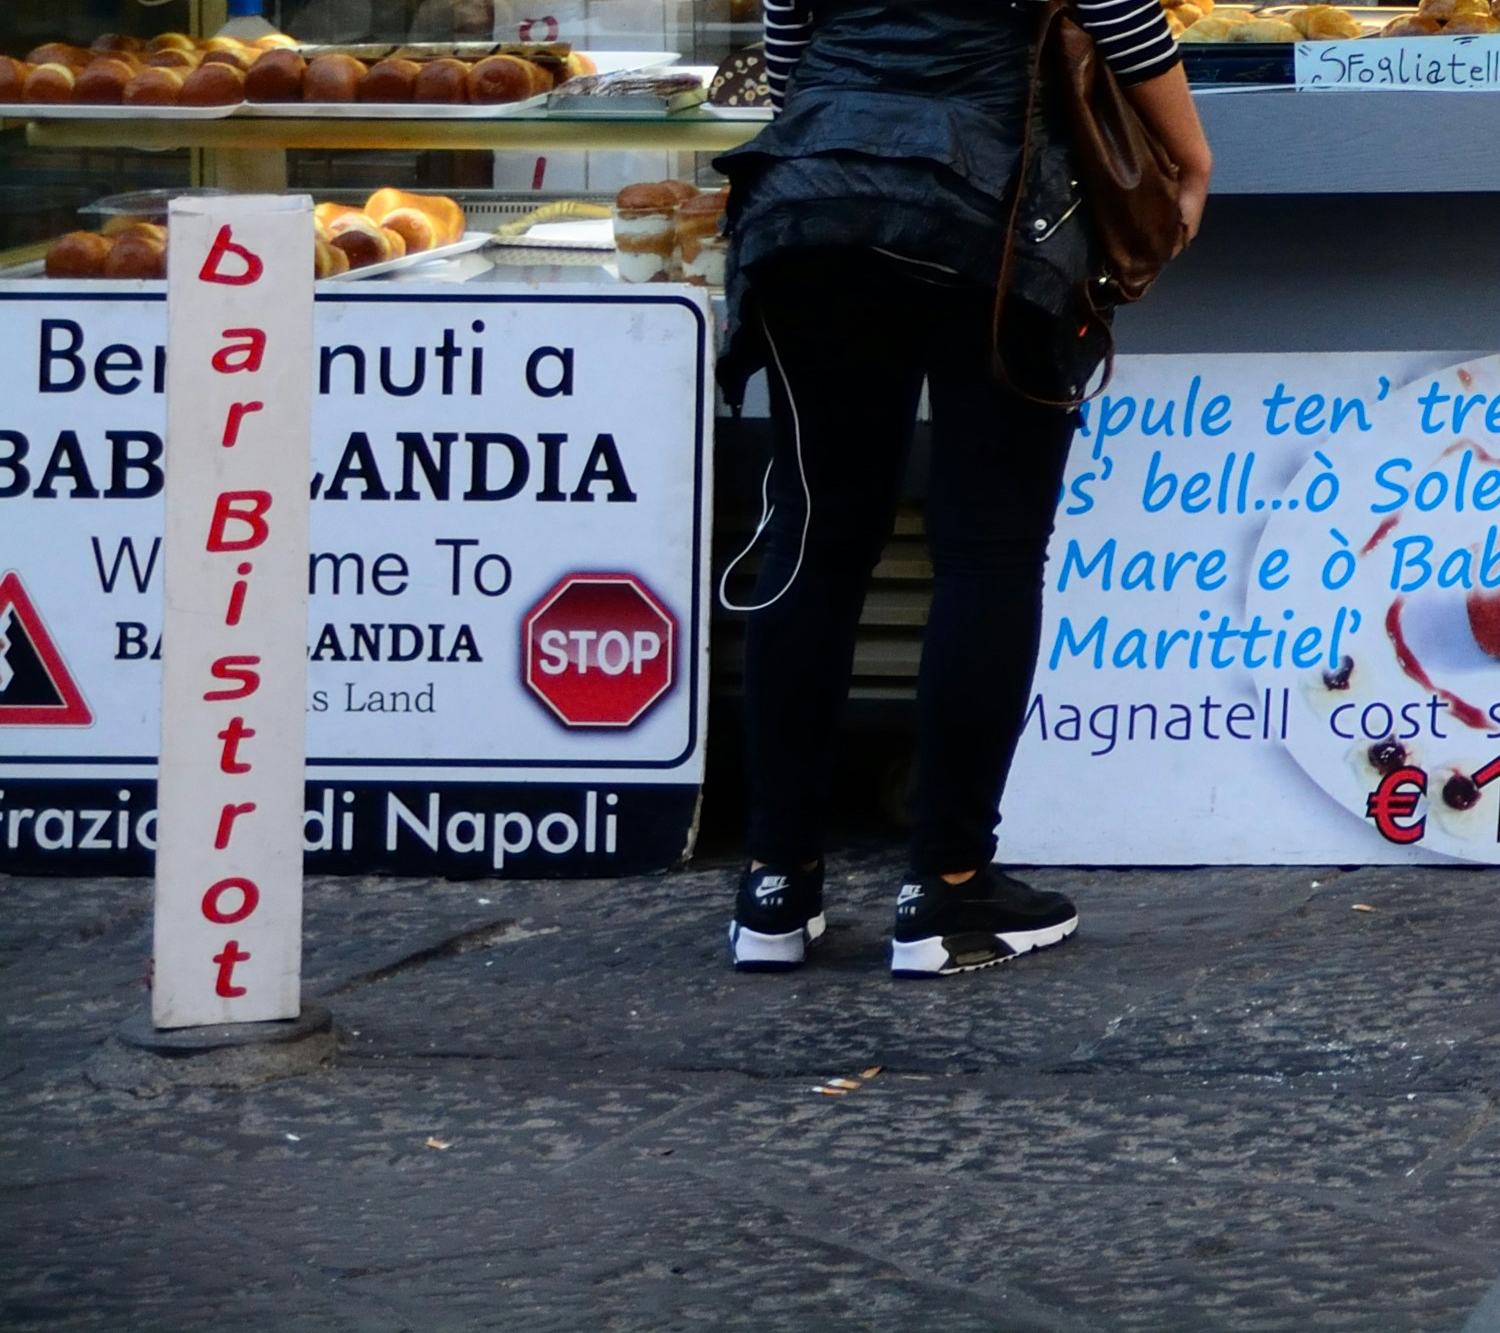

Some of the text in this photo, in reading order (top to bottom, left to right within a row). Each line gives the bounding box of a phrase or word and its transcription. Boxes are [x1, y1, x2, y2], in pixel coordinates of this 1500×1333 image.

[525, 348, 575, 398] a
[437, 539, 513, 596] To
[1057, 537, 1226, 593] Mare
[1258, 548, 1291, 591] e
[539, 629, 661, 676] STOP
[345, 684, 436, 714] Land
[1329, 693, 1449, 741] cost
[200, 489, 272, 999] Bistrot
[302, 788, 354, 851] di
[387, 793, 618, 869] Napoli
